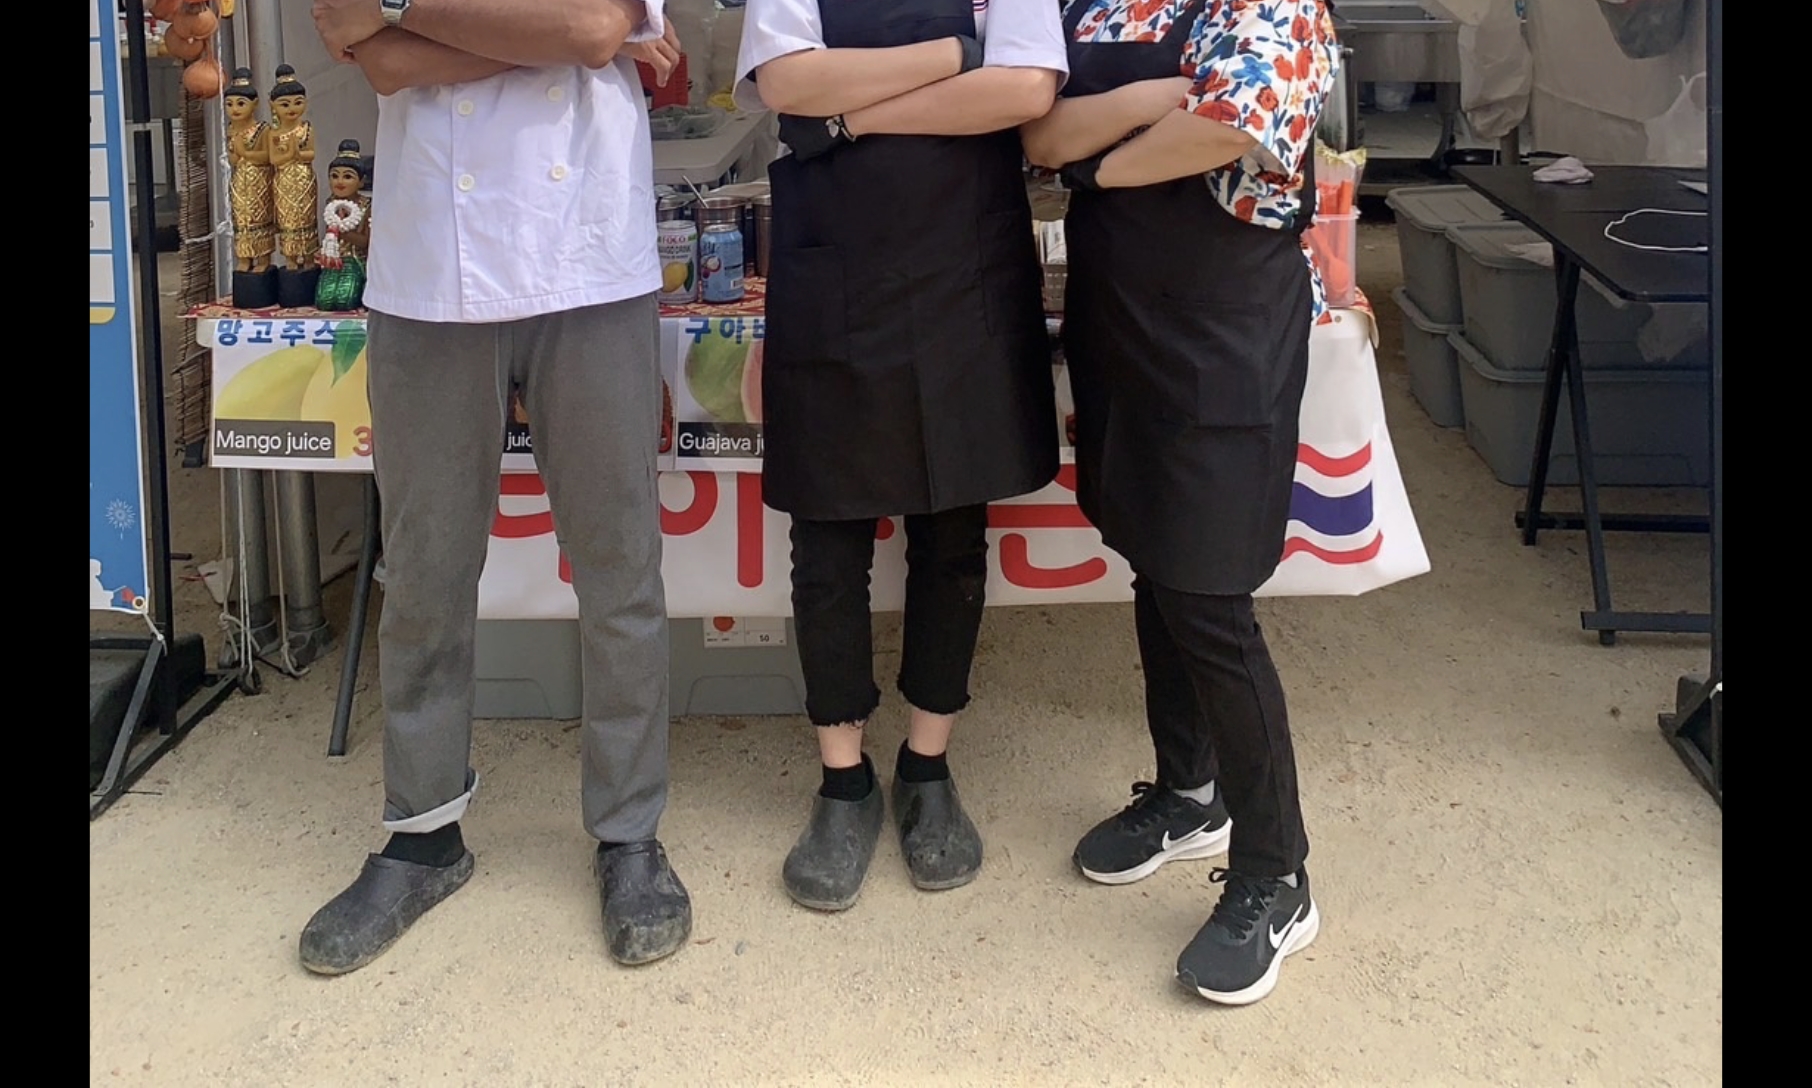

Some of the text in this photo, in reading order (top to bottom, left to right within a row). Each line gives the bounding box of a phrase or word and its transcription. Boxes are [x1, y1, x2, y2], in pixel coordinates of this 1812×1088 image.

[217, 319, 338, 347] 망고주스
[216, 430, 332, 455] Mango juice
[506, 431, 533, 451] juic
[679, 432, 751, 455] Guajava
